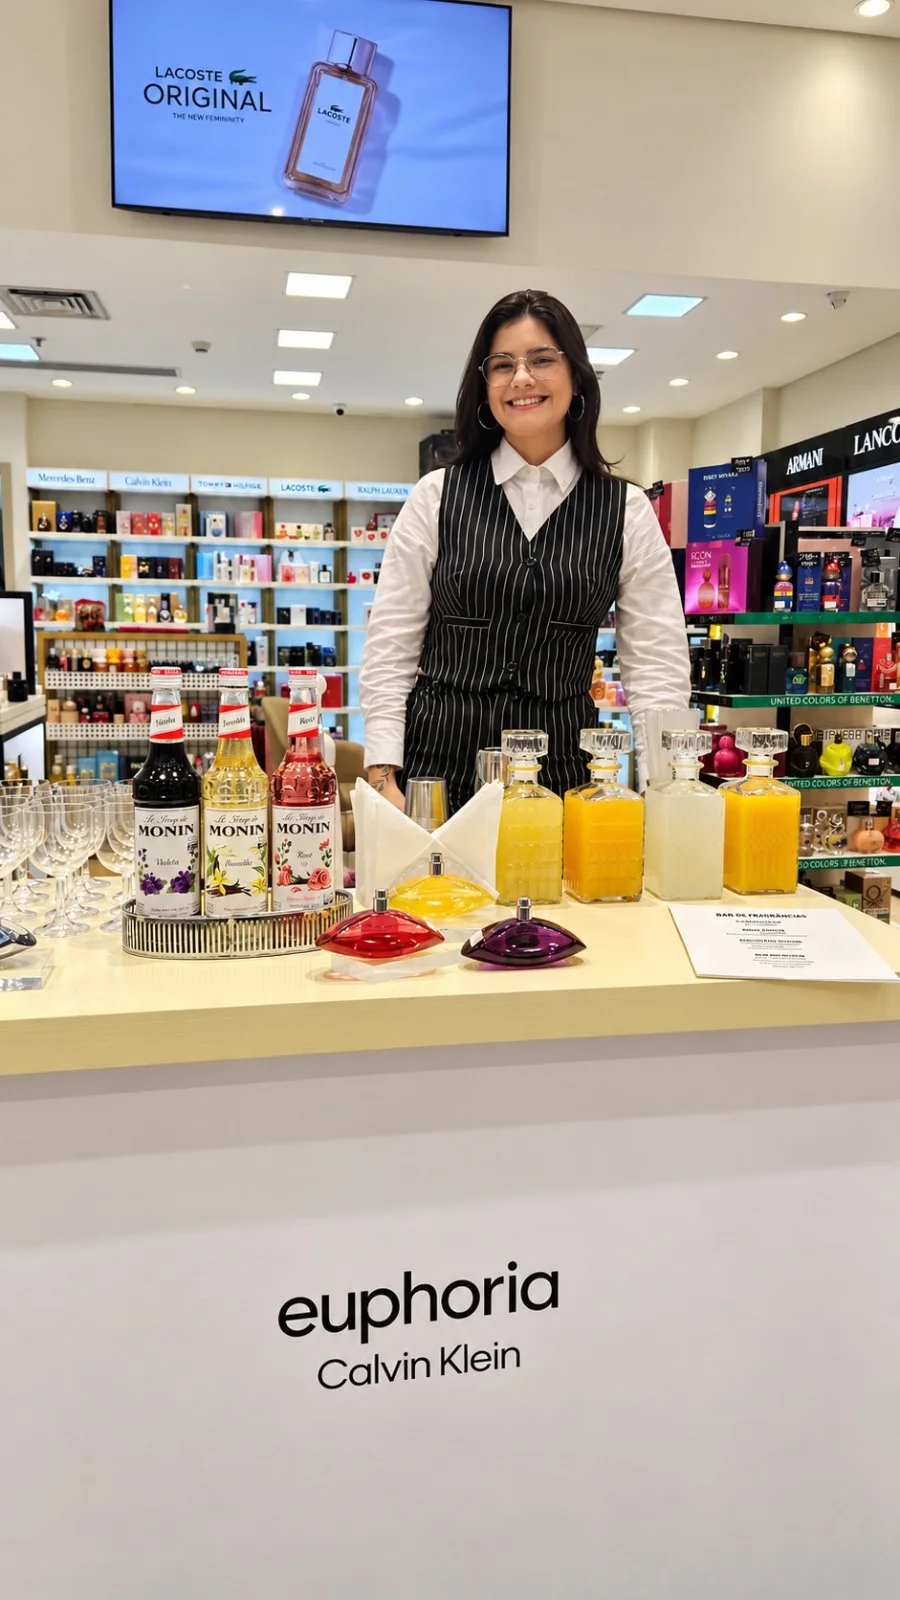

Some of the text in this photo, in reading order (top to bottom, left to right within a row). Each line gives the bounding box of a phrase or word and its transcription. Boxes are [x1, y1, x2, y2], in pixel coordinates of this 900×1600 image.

[155, 66, 223, 82] LACOSTE
[143, 83, 272, 112] ORIGINAL
[172, 112, 186, 120] THE
[187, 113, 205, 121] NEW
[317, 107, 351, 124] LACOSTE
[785, 447, 824, 476] ARMANI
[125, 476, 171, 487] Calvin Klein
[280, 484, 315, 492] LACOSTE
[357, 486, 381, 494] RALPH
[770, 697, 801, 705] UNITED
[802, 696, 835, 705] COLORS
[837, 696, 848, 704] OF
[811, 779, 841, 787] COLORS
[138, 824, 194, 837] MONIN
[209, 823, 264, 837] MONIN
[276, 821, 331, 835] MONIN
[809, 860, 838, 868] COLORS
[277, 1260, 559, 1345] euphoria
[317, 1341, 521, 1390] Calvin Klein
